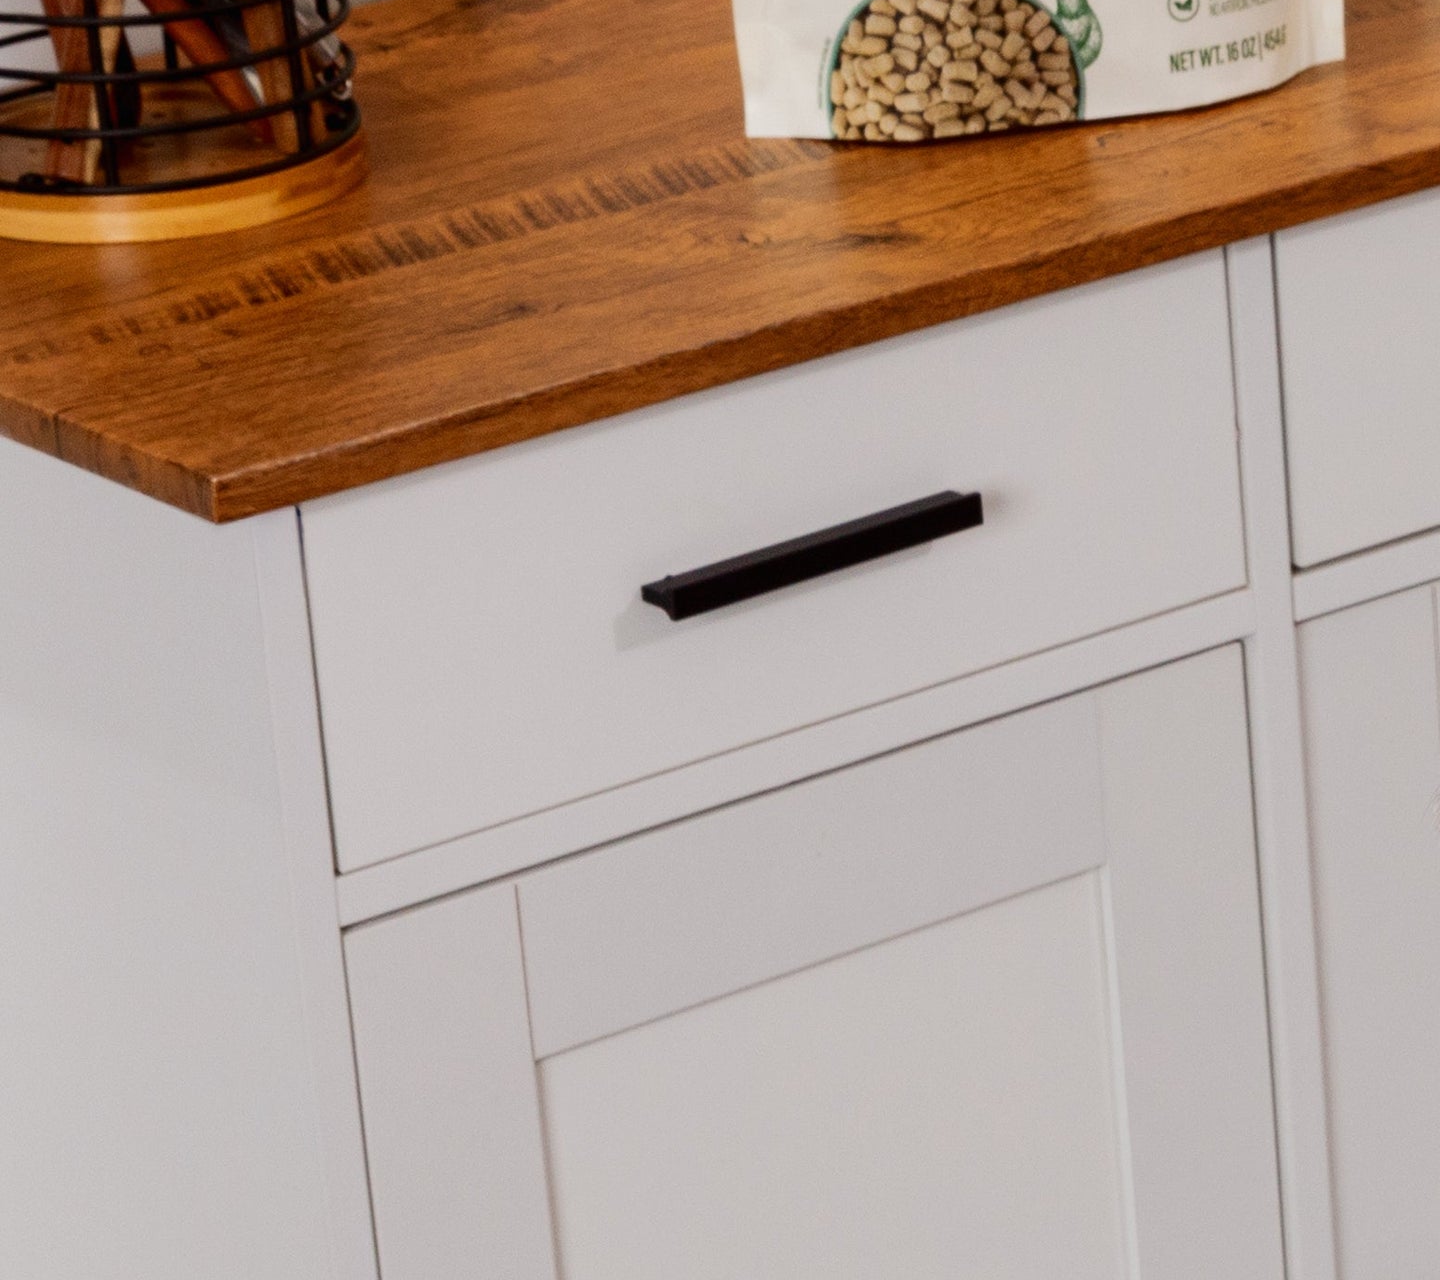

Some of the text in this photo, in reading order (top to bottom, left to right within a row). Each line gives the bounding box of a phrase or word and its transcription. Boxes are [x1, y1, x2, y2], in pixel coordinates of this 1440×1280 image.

[1169, 49, 1195, 72] NET
[1200, 44, 1225, 68] WT.
[1227, 40, 1240, 62] 16
[1242, 35, 1256, 59] OZ
